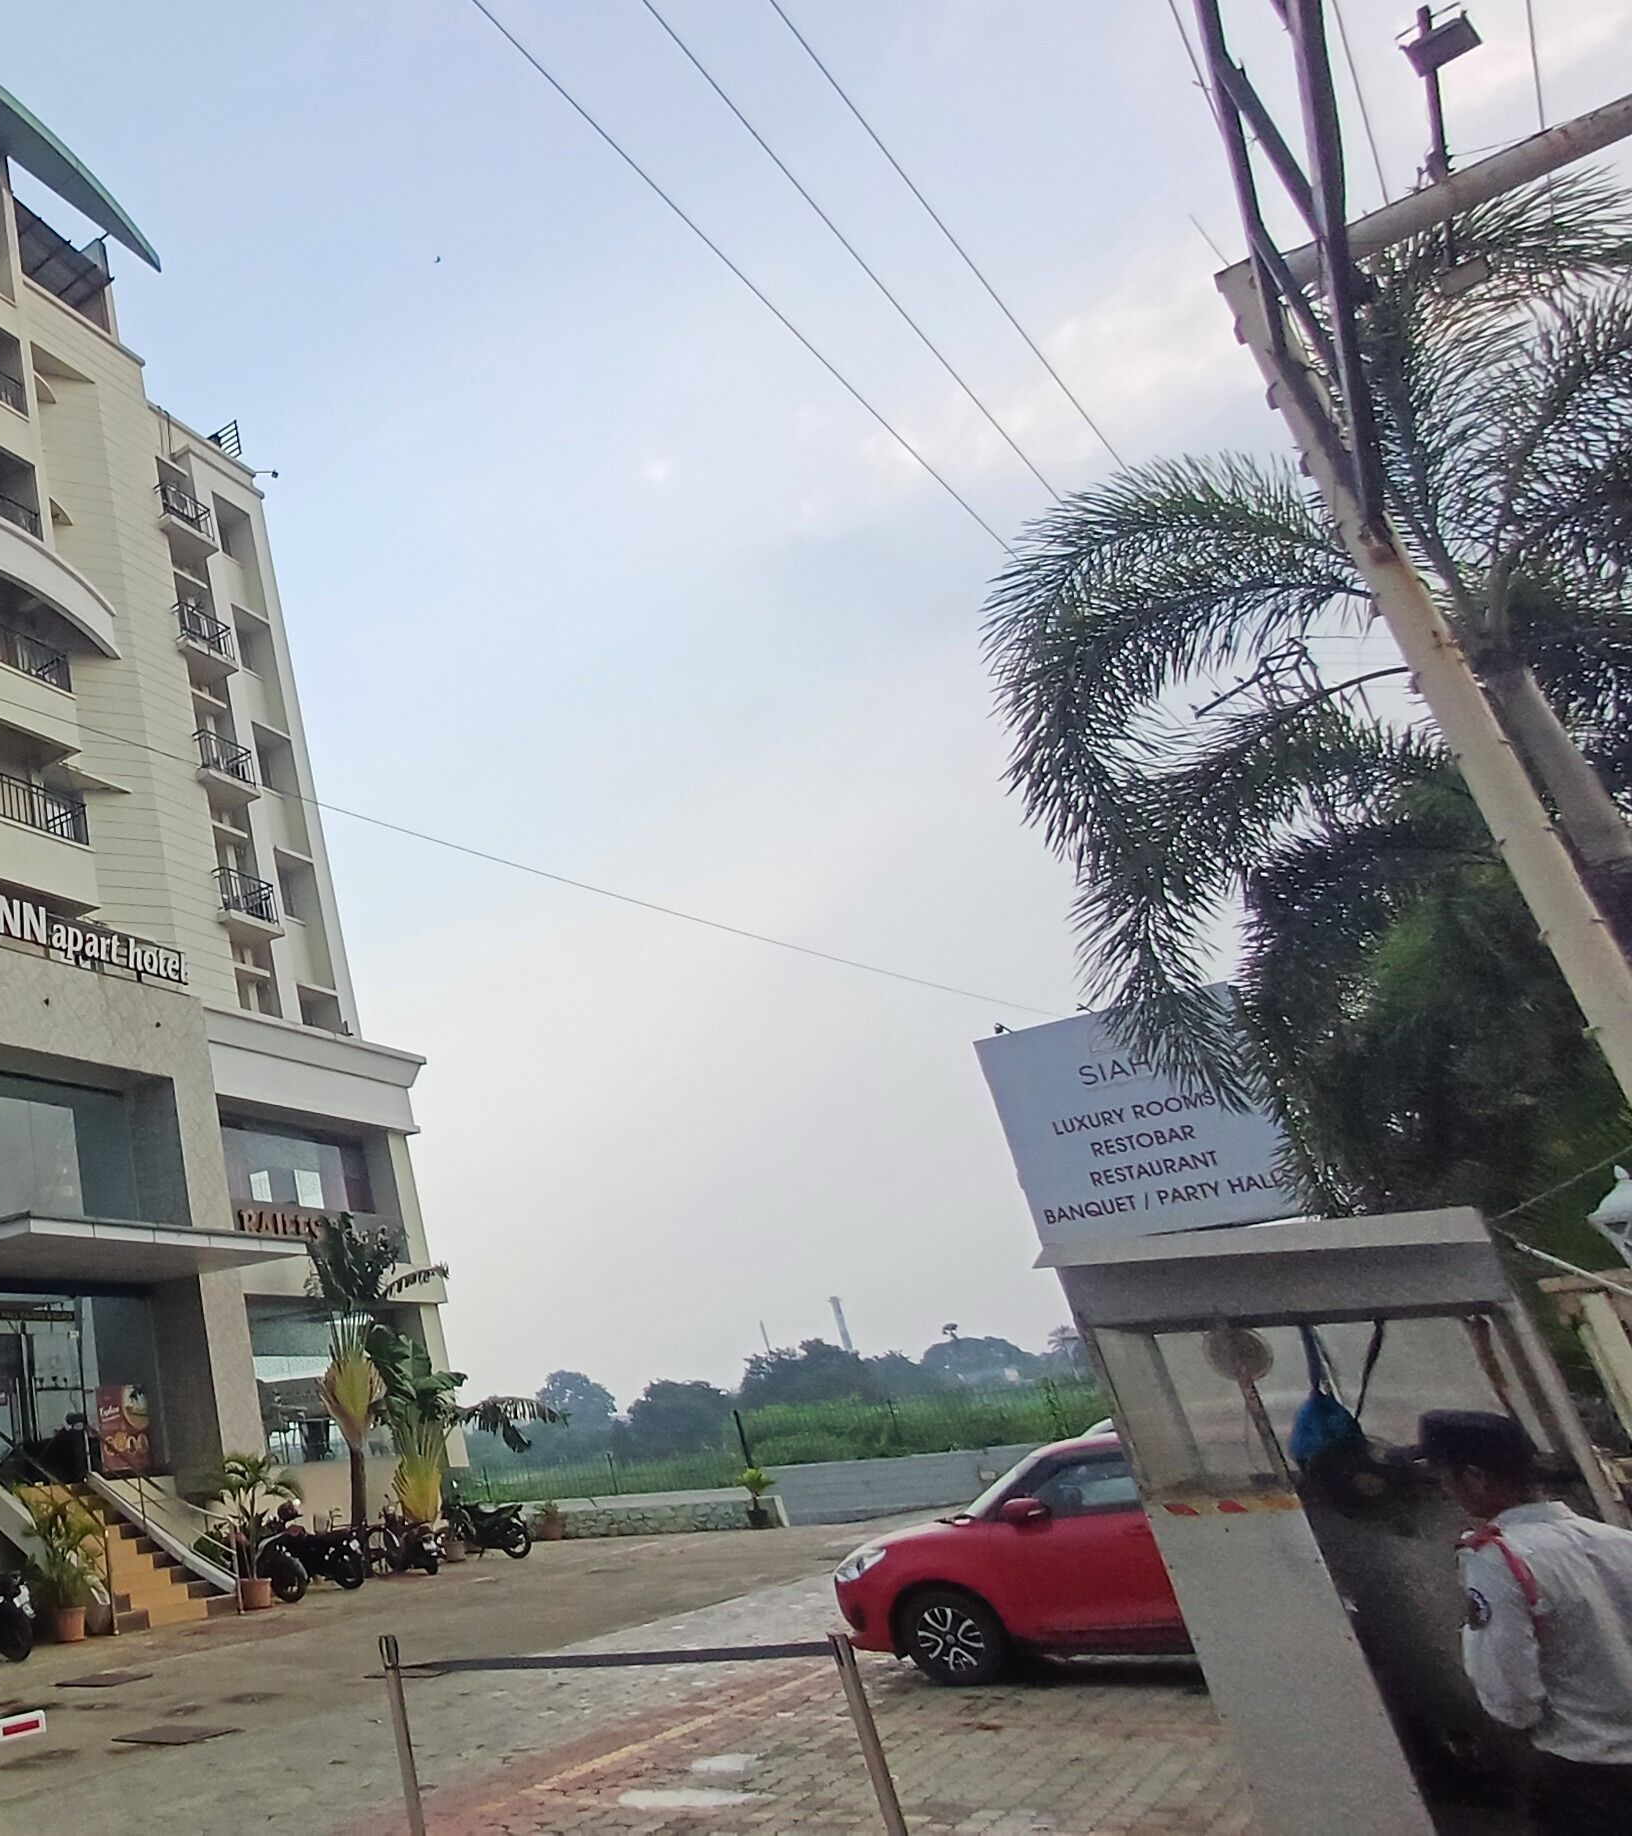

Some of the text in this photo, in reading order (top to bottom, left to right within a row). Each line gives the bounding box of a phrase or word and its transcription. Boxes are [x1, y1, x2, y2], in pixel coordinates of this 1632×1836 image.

[51, 923, 120, 965] apart
[128, 937, 187, 983] hotel
[1052, 1090, 1217, 1136] LUXURY ROOMS
[1089, 1124, 1197, 1157] RESTOBAR
[1089, 1150, 1219, 1187] RESTAURANT
[1044, 1194, 1138, 1225] BANQUET
[1157, 1180, 1221, 1206] PARTY
